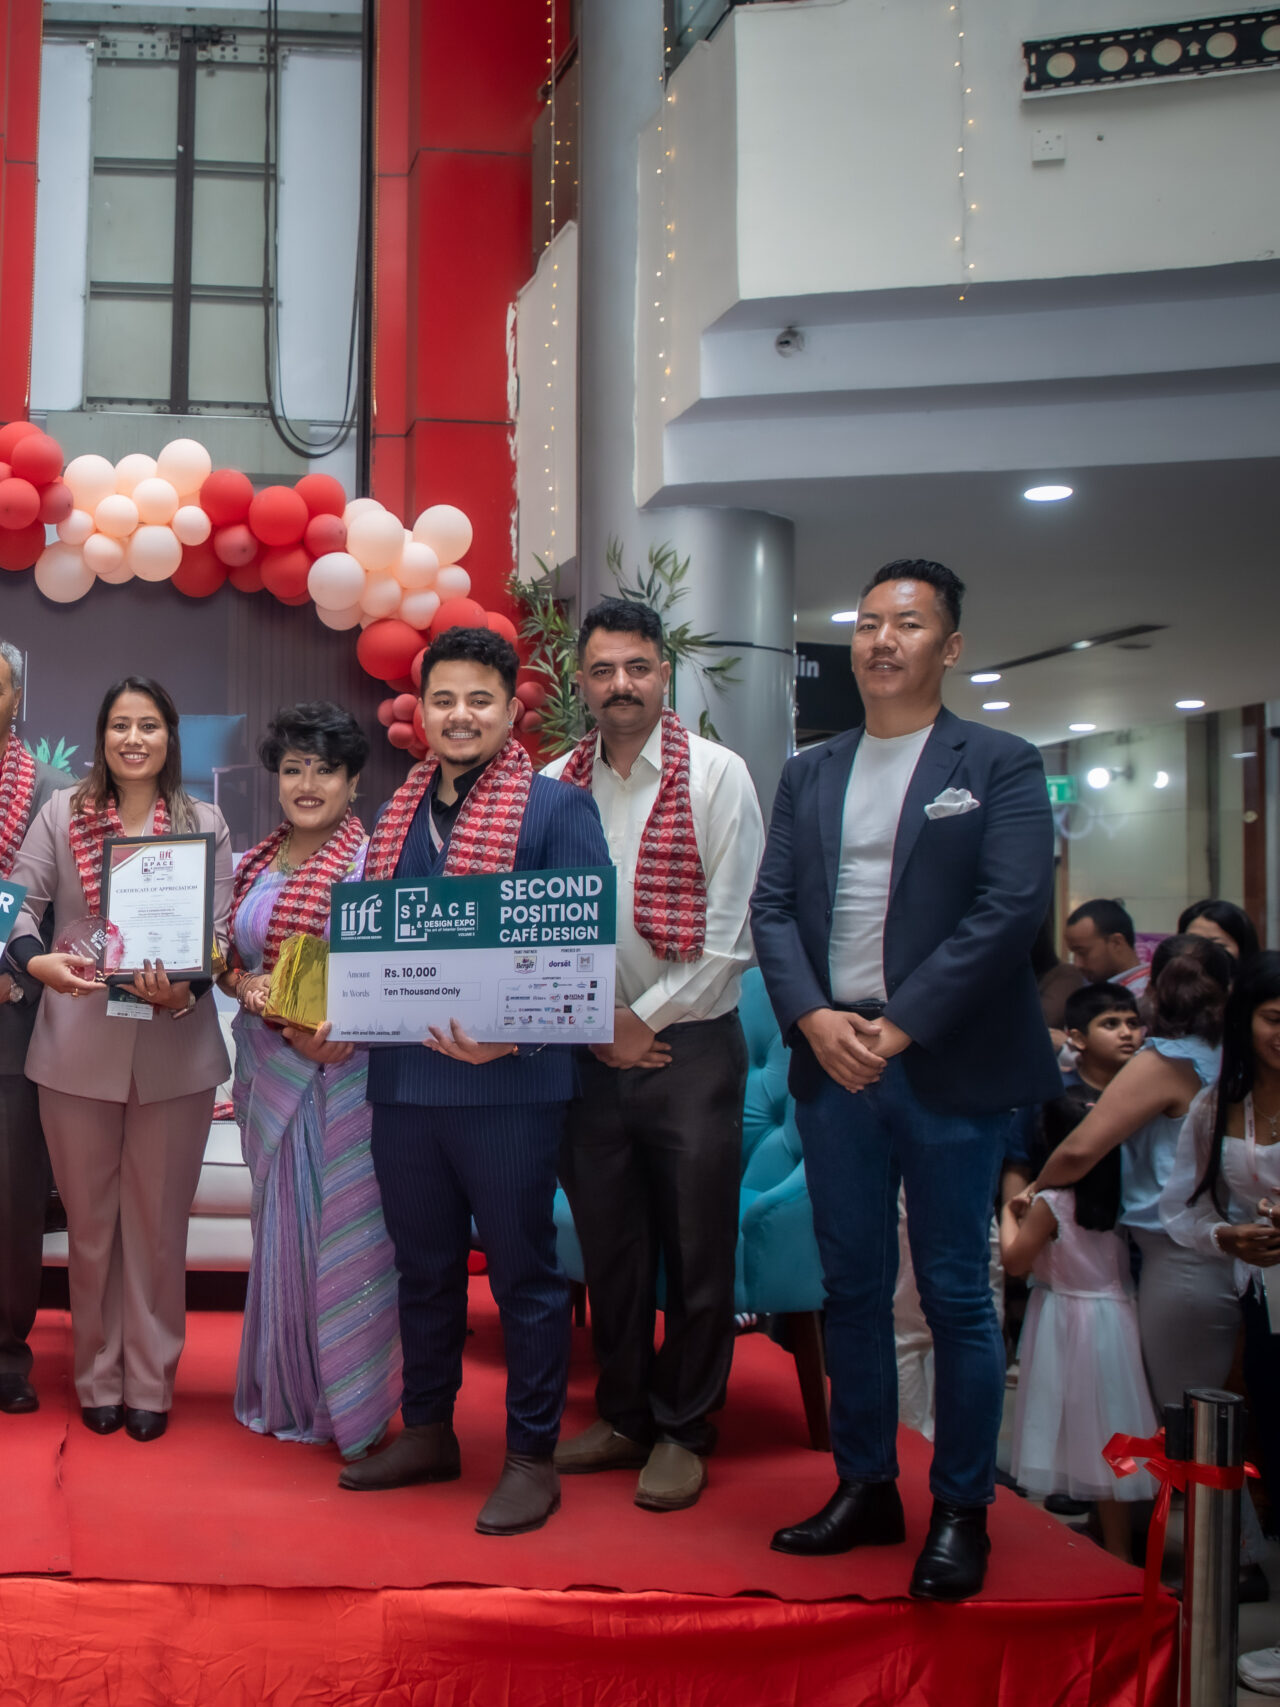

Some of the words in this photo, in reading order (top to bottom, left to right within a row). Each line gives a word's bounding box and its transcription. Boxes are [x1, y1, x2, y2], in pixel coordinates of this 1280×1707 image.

[500, 874, 602, 901] SECOND
[400, 901, 476, 919] SPACE
[500, 902, 598, 924] POSITION
[424, 919, 453, 928] DESIGN
[454, 918, 475, 927] EXPO
[499, 925, 538, 943] CAFÉ
[541, 926, 598, 941] DESIGN
[347, 970, 370, 978] Amount
[384, 968, 400, 978] Rs.
[402, 966, 437, 979] 10,000
[342, 990, 348, 998] In
[349, 989, 370, 998] Words
[384, 988, 398, 996] Ten
[400, 987, 440, 996] Thousand
[442, 987, 461, 997] Only
